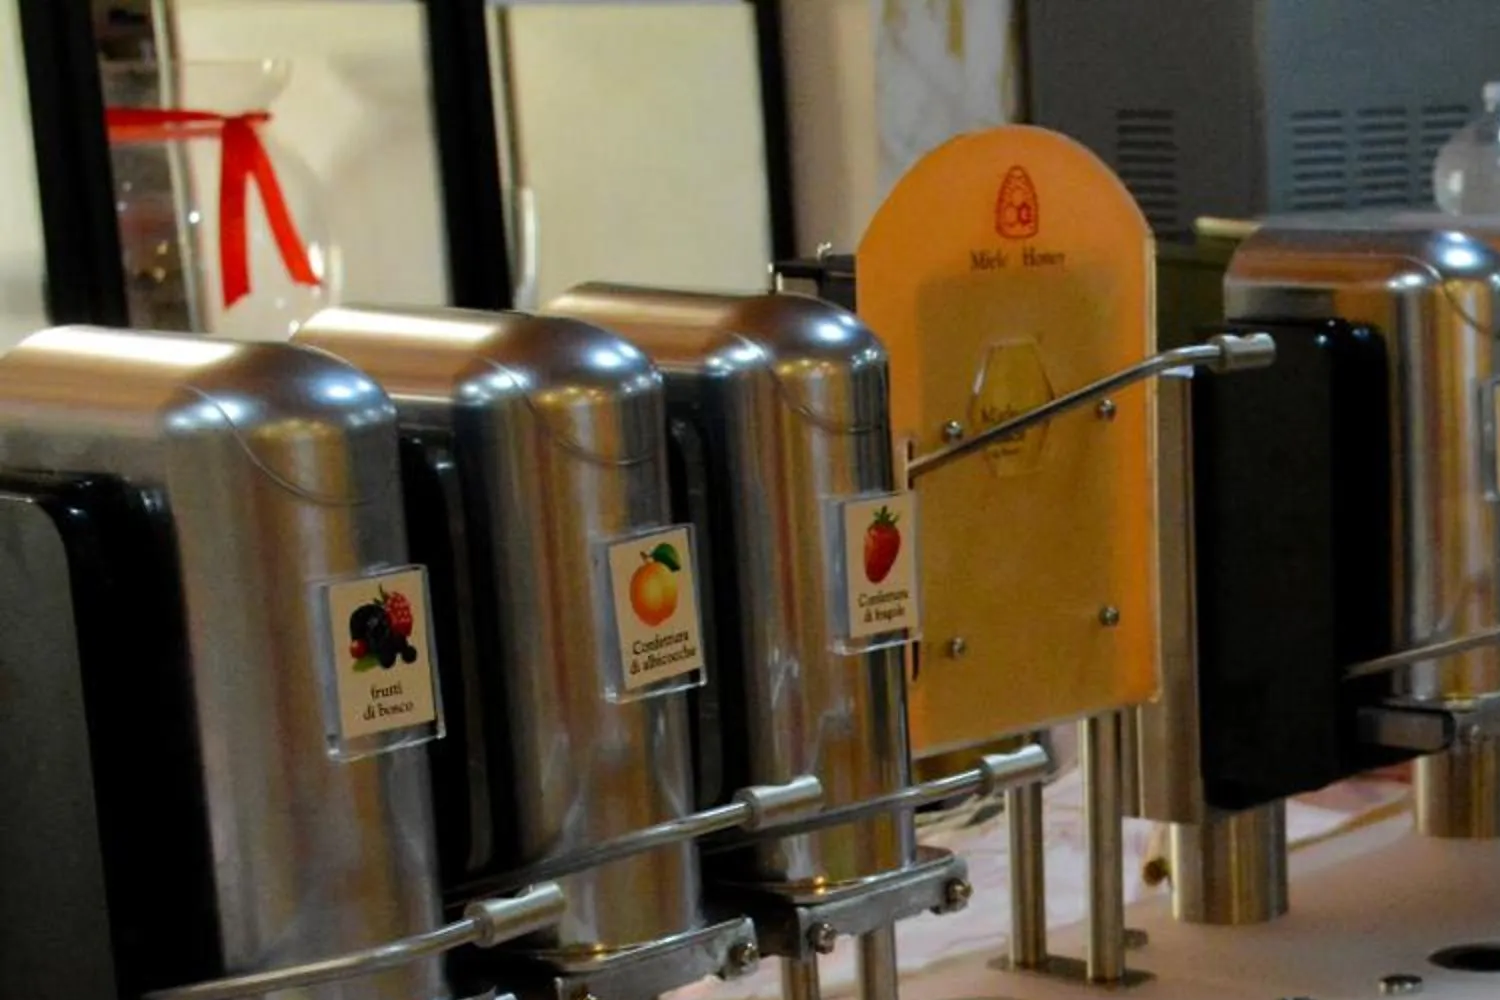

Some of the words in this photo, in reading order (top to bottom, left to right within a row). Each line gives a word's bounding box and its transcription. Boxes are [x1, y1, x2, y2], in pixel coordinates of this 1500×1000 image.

[630, 659, 641, 675] di
[363, 703, 376, 720] di
[378, 700, 414, 717] bosco
